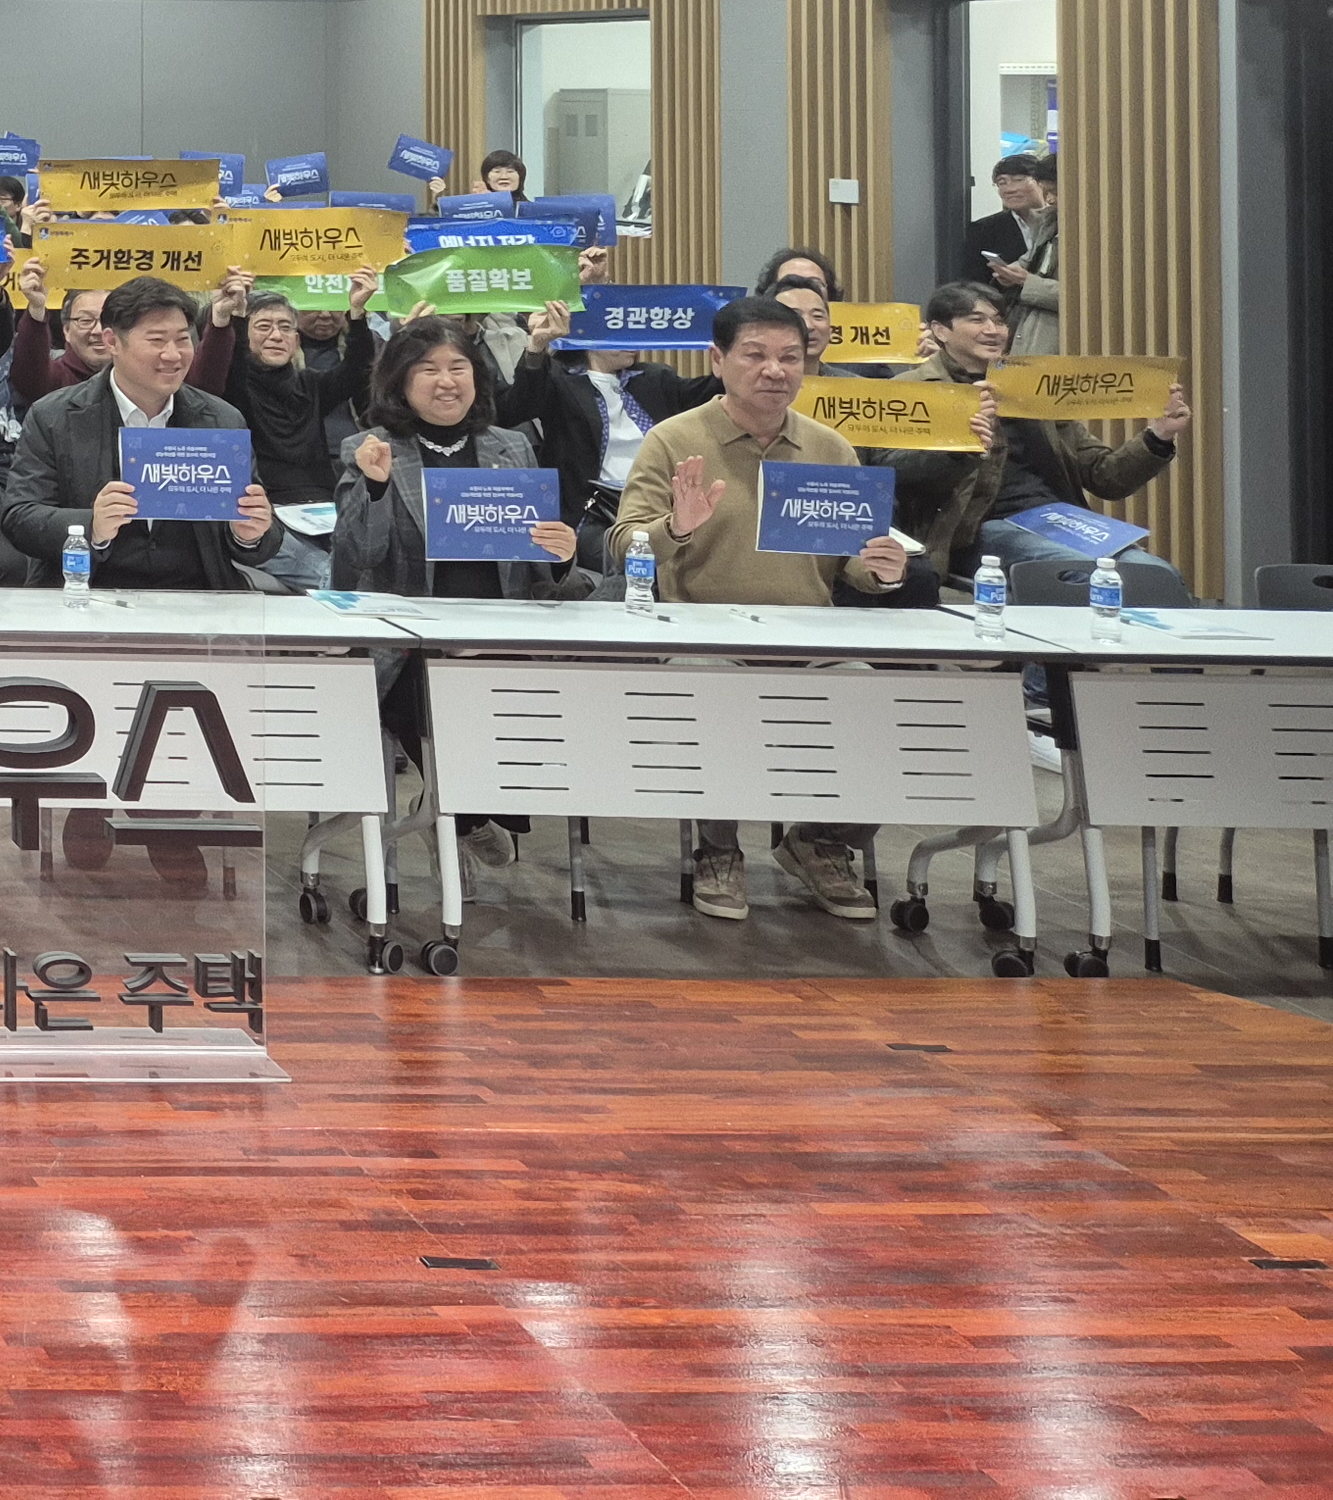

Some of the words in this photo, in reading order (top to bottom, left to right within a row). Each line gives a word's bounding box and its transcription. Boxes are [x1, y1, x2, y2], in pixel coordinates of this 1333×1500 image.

[80, 170, 177, 198] 새빛하우스
[259, 226, 363, 260] 새빛하우스
[70, 248, 154, 271] 주거환경
[160, 250, 203, 272] 개선
[445, 268, 533, 293] 품질확보
[604, 306, 695, 330] 경관향상
[850, 325, 891, 346] 개선
[1035, 373, 1134, 405] 새빛하우스
[813, 396, 930, 430] 새빛하우스
[141, 463, 232, 491] 새빛하우스
[446, 504, 541, 532] 새빛하우스
[780, 498, 873, 526] 새빛하우스
[118, 948, 264, 1034] 주택
